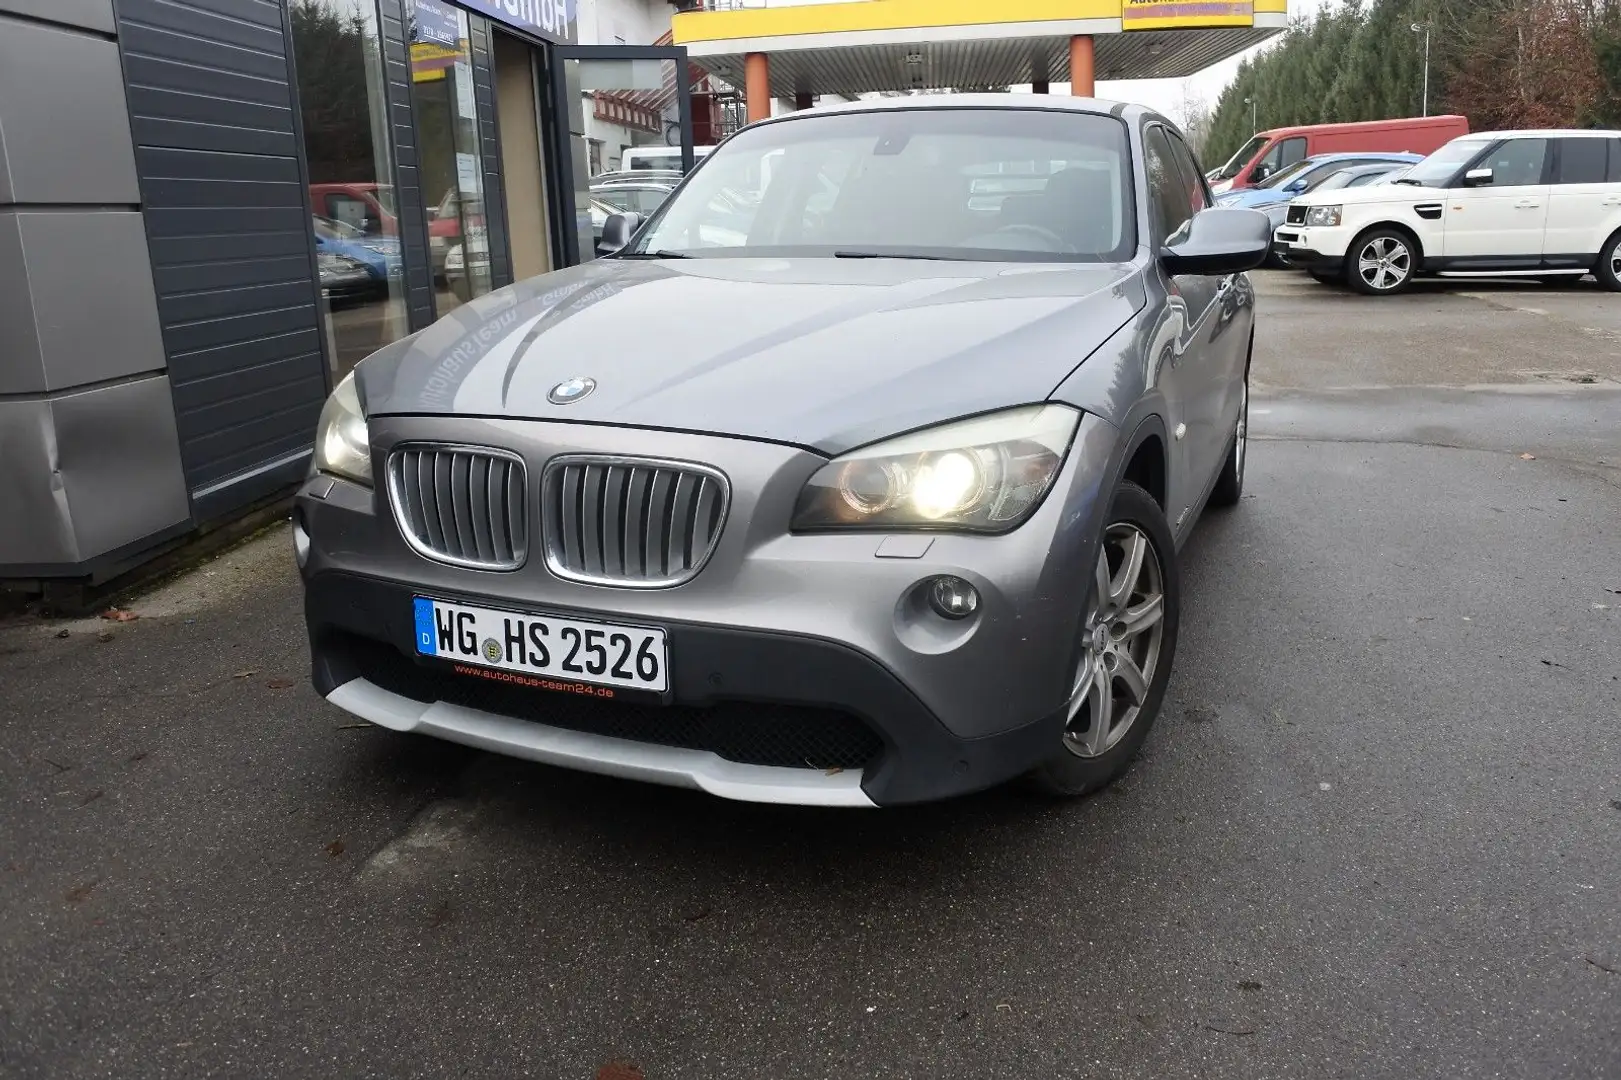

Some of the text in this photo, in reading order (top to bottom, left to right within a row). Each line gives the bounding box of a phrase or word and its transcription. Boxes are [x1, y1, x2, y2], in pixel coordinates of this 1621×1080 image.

[422, 632, 430, 645] D
[435, 607, 659, 682] WG HS 2526
[454, 664, 614, 698] www.autohaus-team24.de
